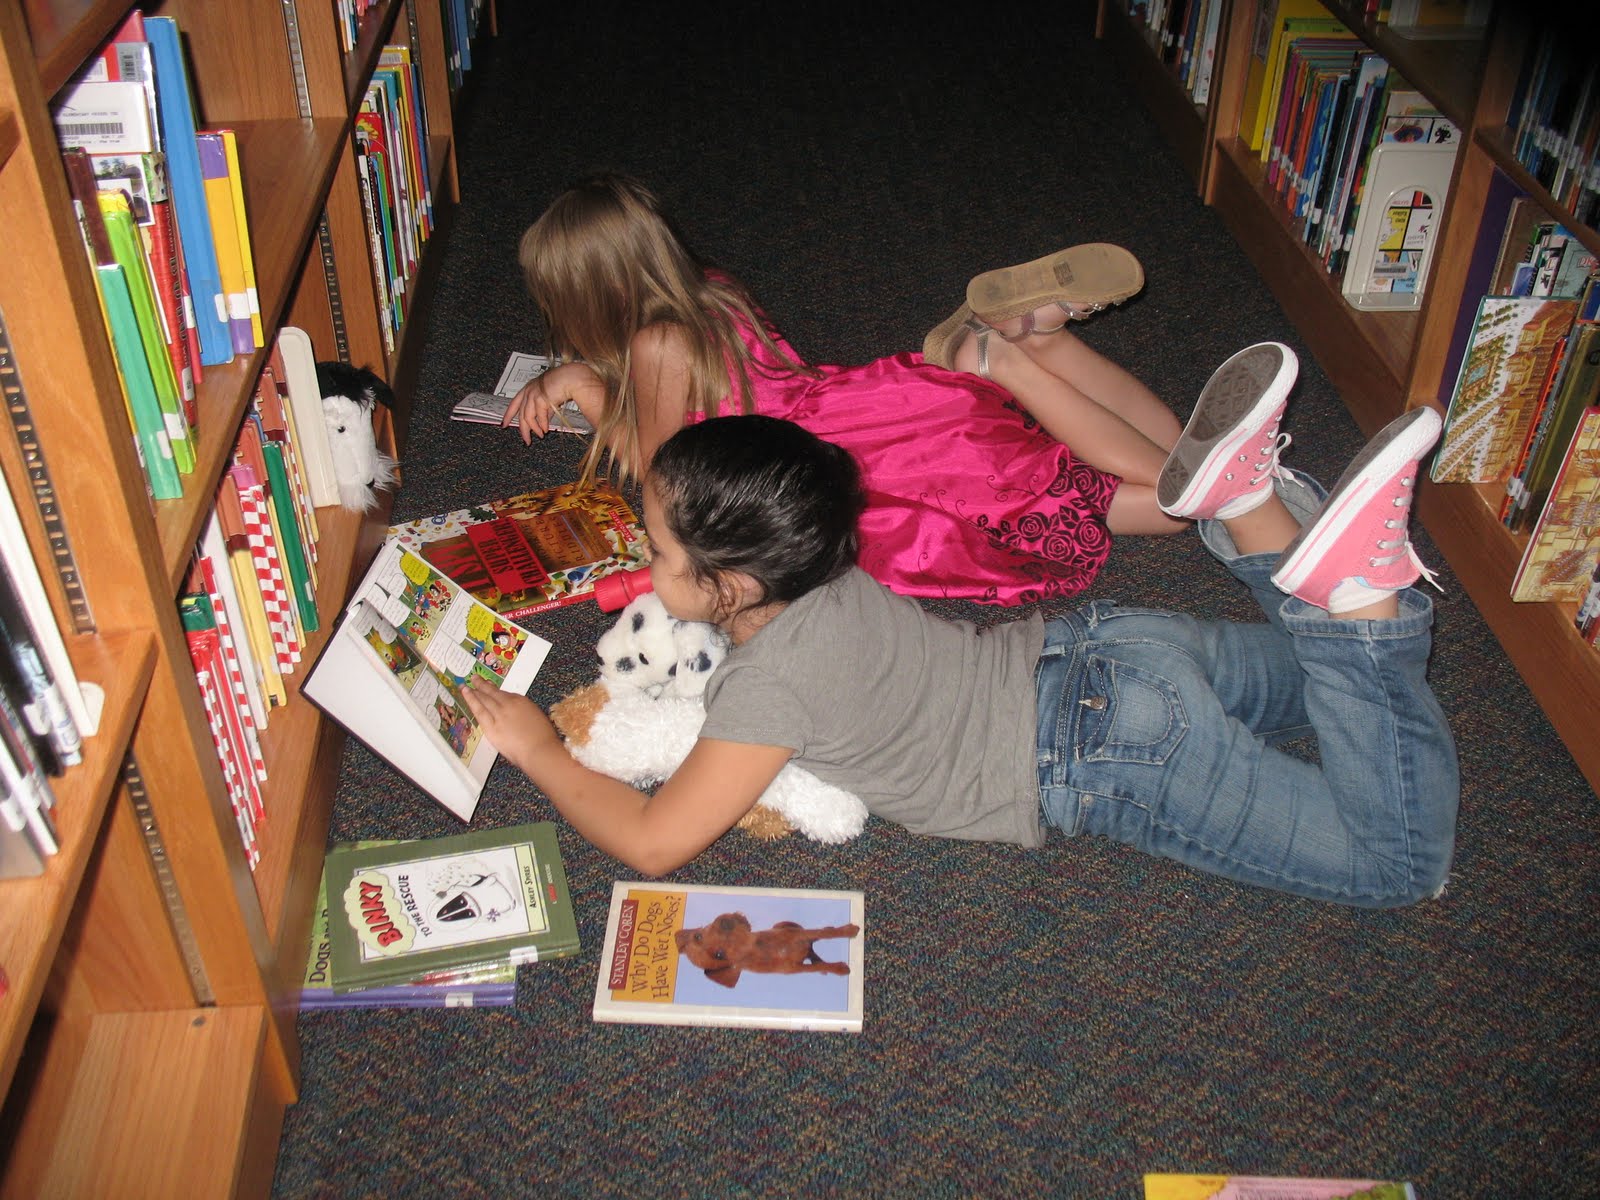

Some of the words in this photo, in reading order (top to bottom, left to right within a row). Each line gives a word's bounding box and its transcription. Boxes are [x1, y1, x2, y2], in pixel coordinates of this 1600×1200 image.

[478, 538, 515, 575] SUPER
[515, 601, 562, 617] CHALLENGER!
[398, 875, 418, 913] RESCUE
[359, 881, 404, 947] BINKY
[411, 912, 425, 927] THE
[618, 904, 634, 939] COREN
[637, 901, 663, 934] Dogs
[656, 895, 682, 936] Noses?
[421, 926, 433, 937] TO
[633, 936, 651, 957] Do
[611, 940, 630, 985] STANLEY
[652, 938, 669, 964] Wet
[630, 960, 651, 995] Why
[651, 965, 671, 999] Have
